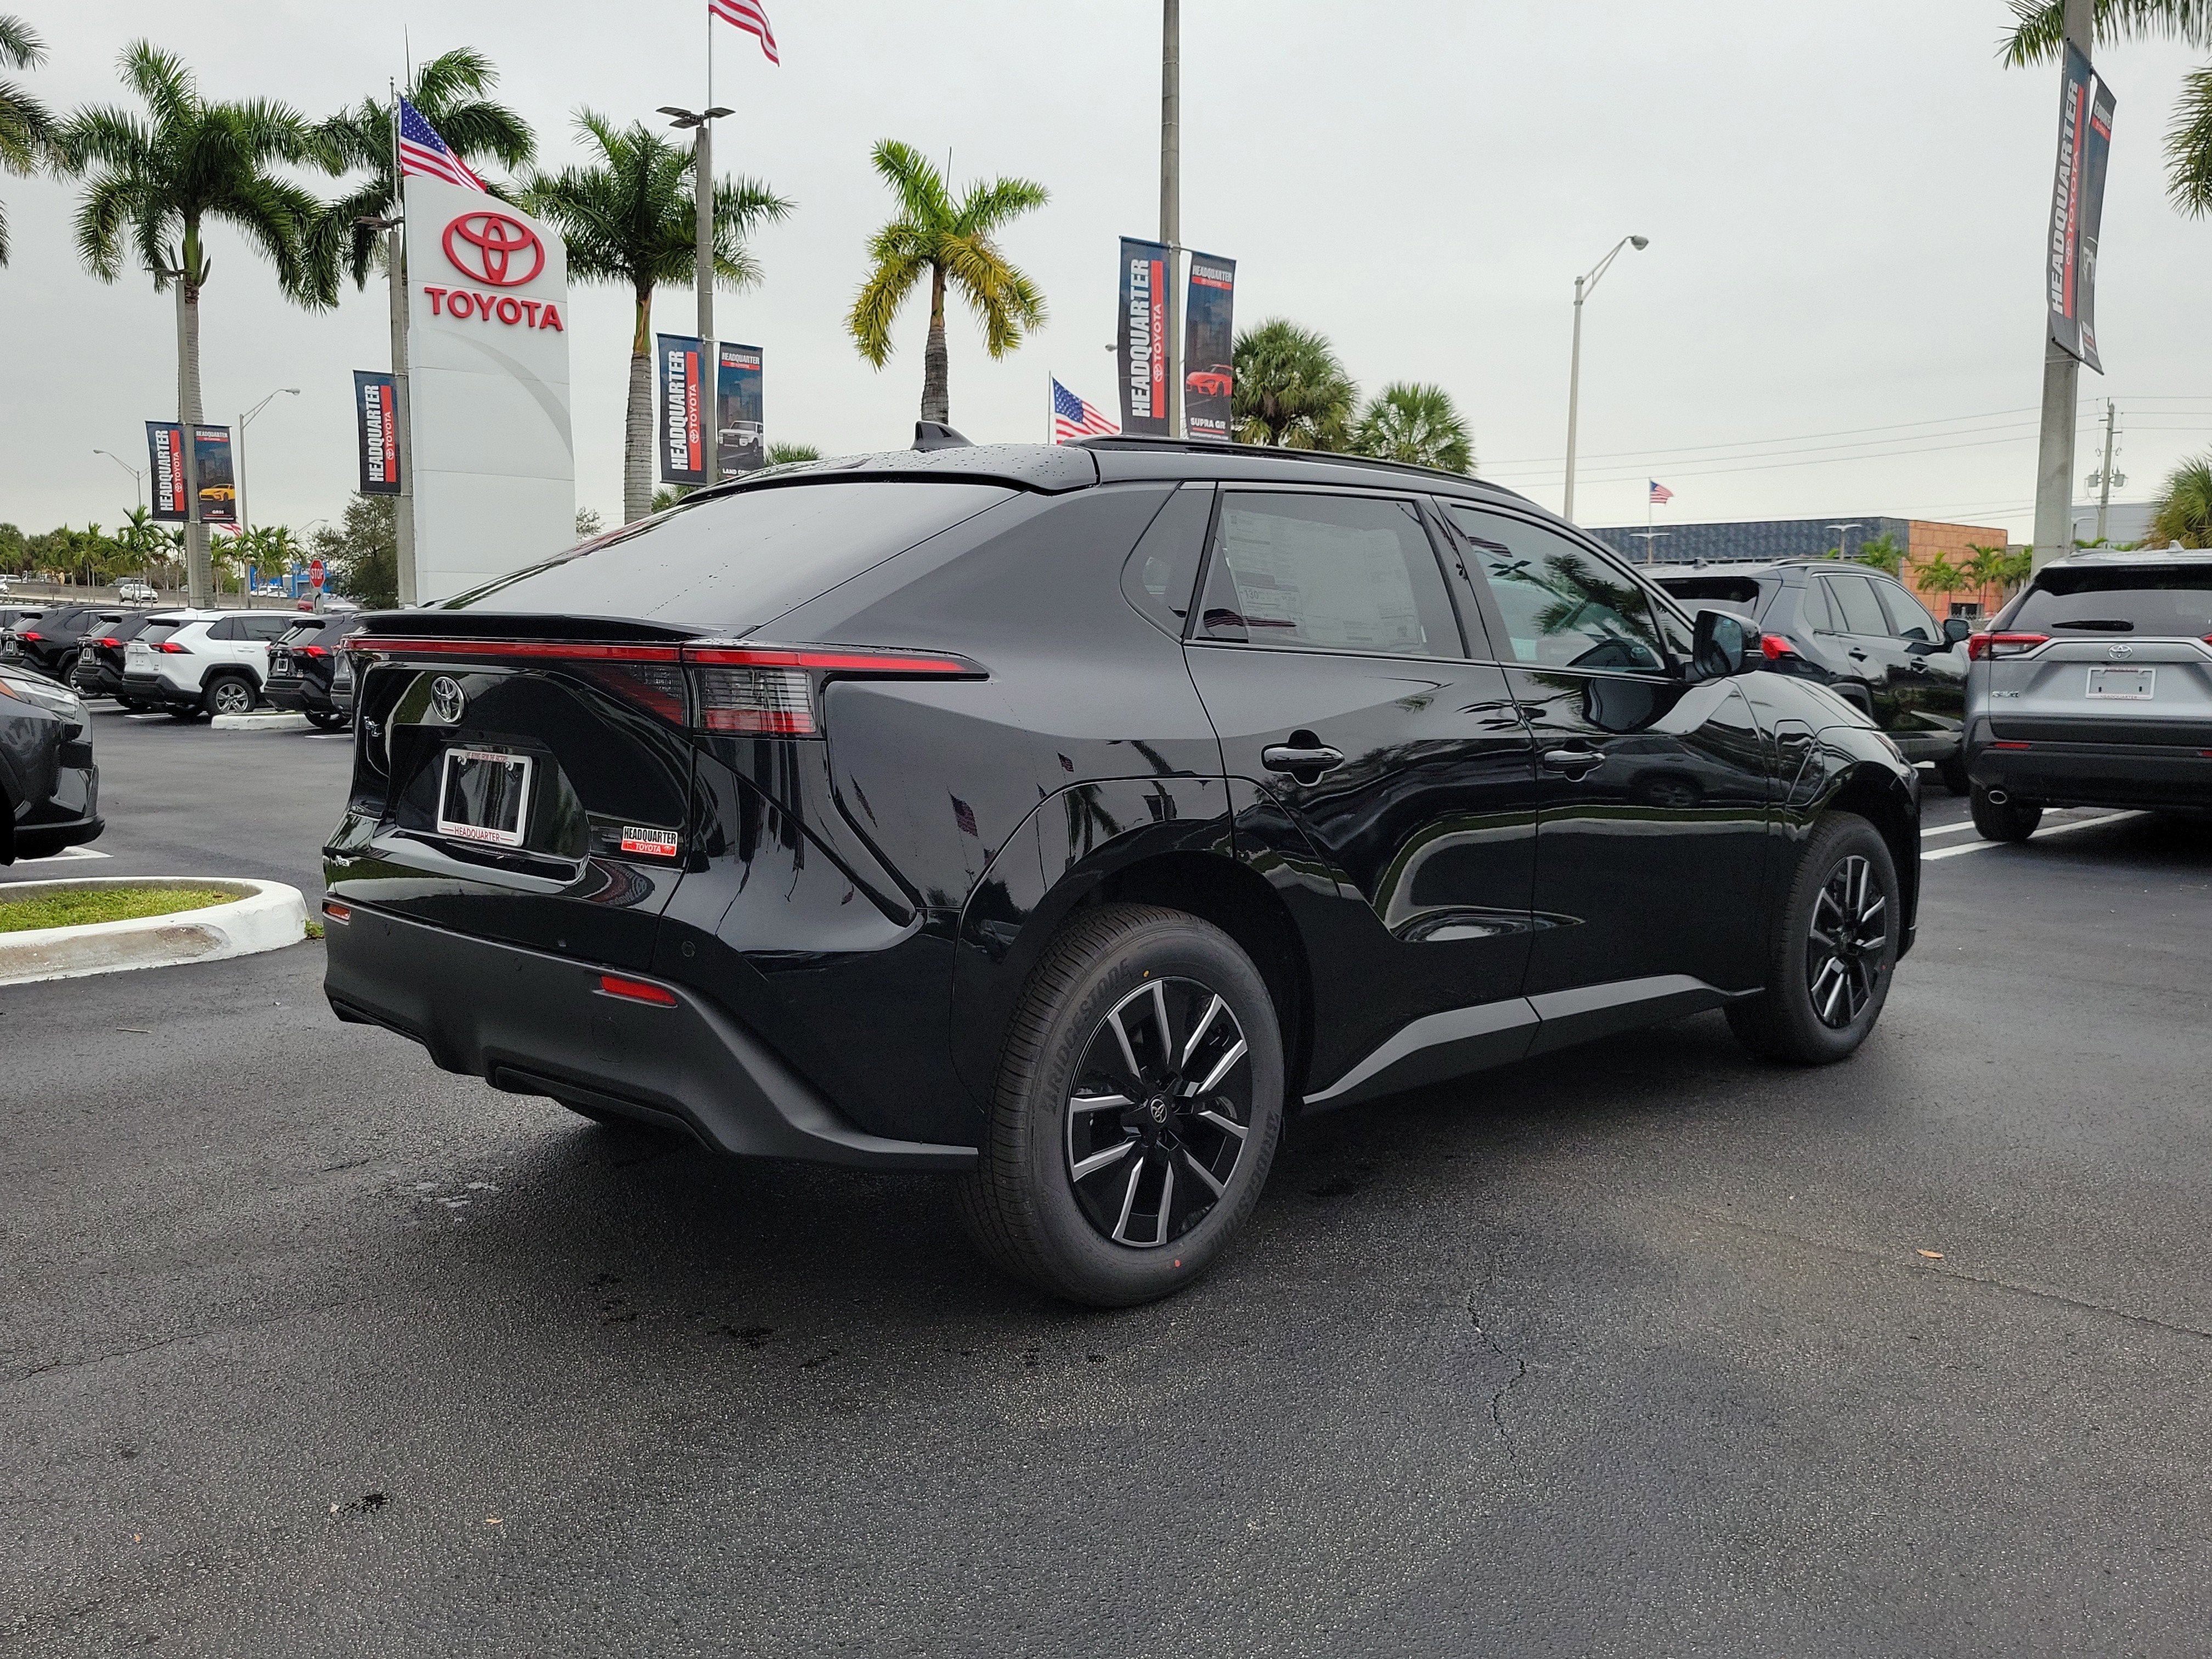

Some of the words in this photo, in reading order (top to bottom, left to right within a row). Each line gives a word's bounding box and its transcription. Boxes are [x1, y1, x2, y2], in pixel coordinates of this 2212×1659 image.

[2051, 78, 2079, 315] HEADQUARTER
[2067, 150, 2079, 235] TOYOTA
[424, 287, 564, 331] TOYOTA
[1130, 259, 1152, 417] HEADQUARTER
[1153, 303, 1161, 363] TOYOTA
[721, 352, 760, 365] HEADQUARTER
[669, 351, 688, 470] HEADQUARTER
[689, 384, 698, 429] TOYOTA
[1190, 417, 1214, 428] SUPRA
[1215, 420, 1226, 430] GR
[364, 385, 384, 482] HEADQUARTER
[385, 411, 393, 448] TOYOTA
[155, 430, 174, 511] HEADQUARTER
[173, 452, 182, 484] TOYOTA
[311, 568, 323, 579] STOP
[454, 826, 500, 842] HEADQUARTER
[624, 827, 676, 844] HEADQUARTER
[636, 843, 662, 853] TOYOTA
